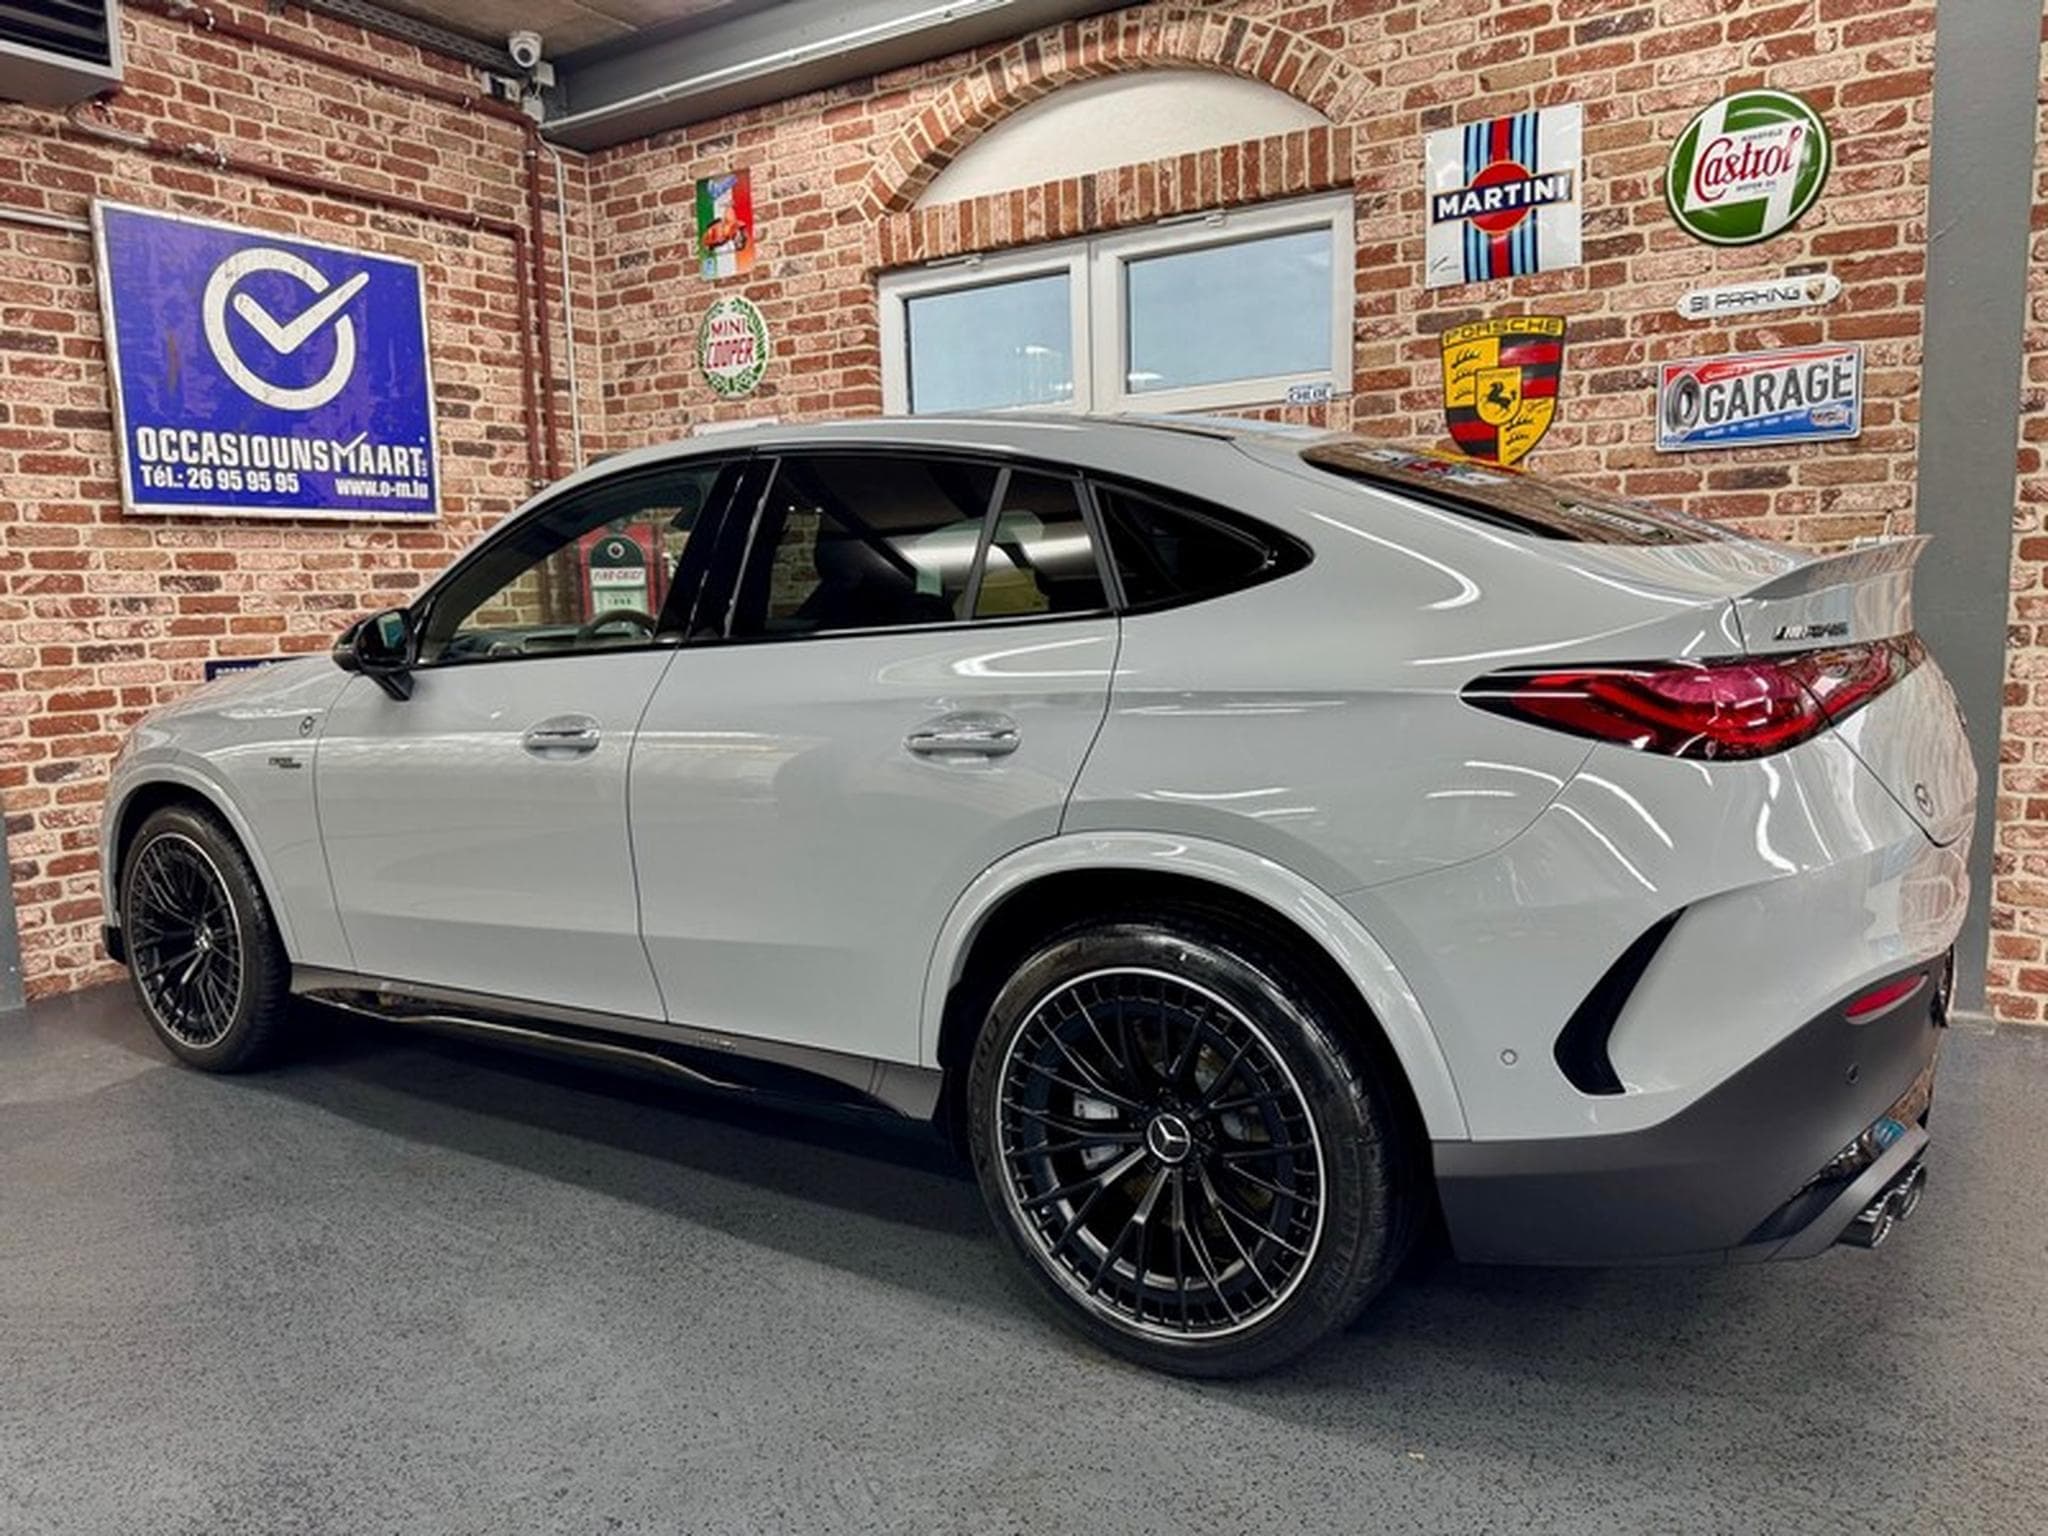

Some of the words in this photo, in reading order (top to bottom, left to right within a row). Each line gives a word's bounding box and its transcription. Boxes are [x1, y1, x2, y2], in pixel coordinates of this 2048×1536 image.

[1693, 125, 1803, 203] Castrol
[1437, 175, 1569, 219] MARTINI
[1714, 286, 1801, 309] PARKING
[711, 318, 747, 337] MINI
[1446, 318, 1560, 344] PORSCHE
[706, 337, 754, 369] COOPER
[1702, 354, 1854, 425] GARAGE
[140, 465, 184, 488] Tél.:
[186, 468, 213, 490] 26
[217, 468, 243, 491] 95
[246, 470, 273, 493] 95
[274, 472, 300, 494] 95
[334, 478, 429, 499] www.o-m.lu
